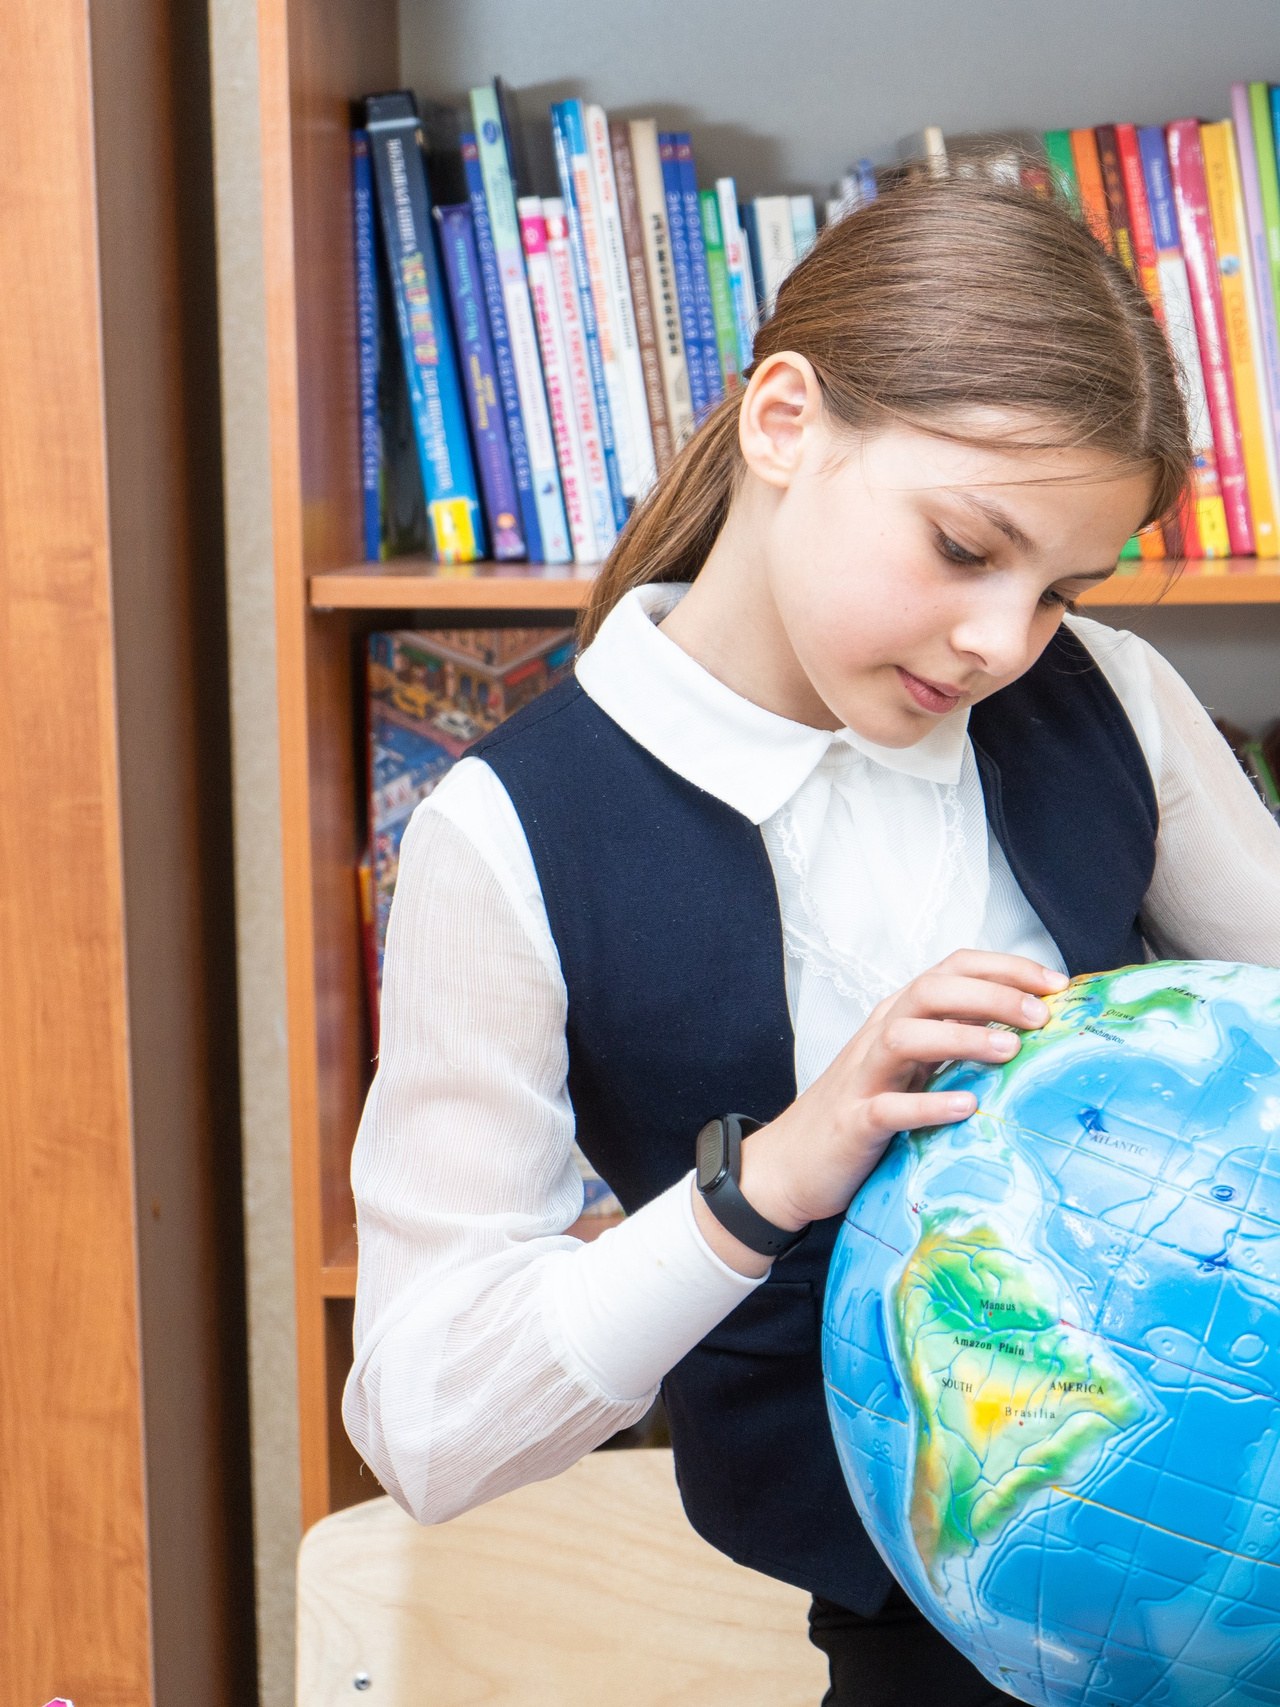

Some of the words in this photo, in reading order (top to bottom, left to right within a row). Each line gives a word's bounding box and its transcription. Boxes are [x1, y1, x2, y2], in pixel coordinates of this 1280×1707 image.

[355, 188, 374, 337] ЭКОЛОГИЧЕСКАЯ
[468, 189, 508, 340] ЭКОЛОГИЧЕСКАЯ
[681, 190, 714, 340] ЭКОЛОГИЧЕСКАЯ
[664, 190, 698, 340] ЭКОЛОГИЧЕСКАЯ
[685, 343, 706, 409] АЗБУКА
[359, 342, 375, 409] АЗБУКА
[494, 343, 519, 411] АЗБУКА
[362, 414, 377, 489] МОСКВЫ
[505, 415, 532, 492] МОСКВЫ
[1084, 1025, 1125, 1045] Washington
[1106, 1008, 1135, 1021] Ottawa
[1090, 1132, 1149, 1157] ATLANTIC
[979, 1299, 1017, 1311] Manaus
[952, 1335, 993, 1351] Amazon
[998, 1341, 1025, 1356] Plain
[941, 1376, 973, 1393] SOUTH
[1050, 1381, 1105, 1395] AMERICA
[1004, 1405, 1057, 1420] Brasilia
